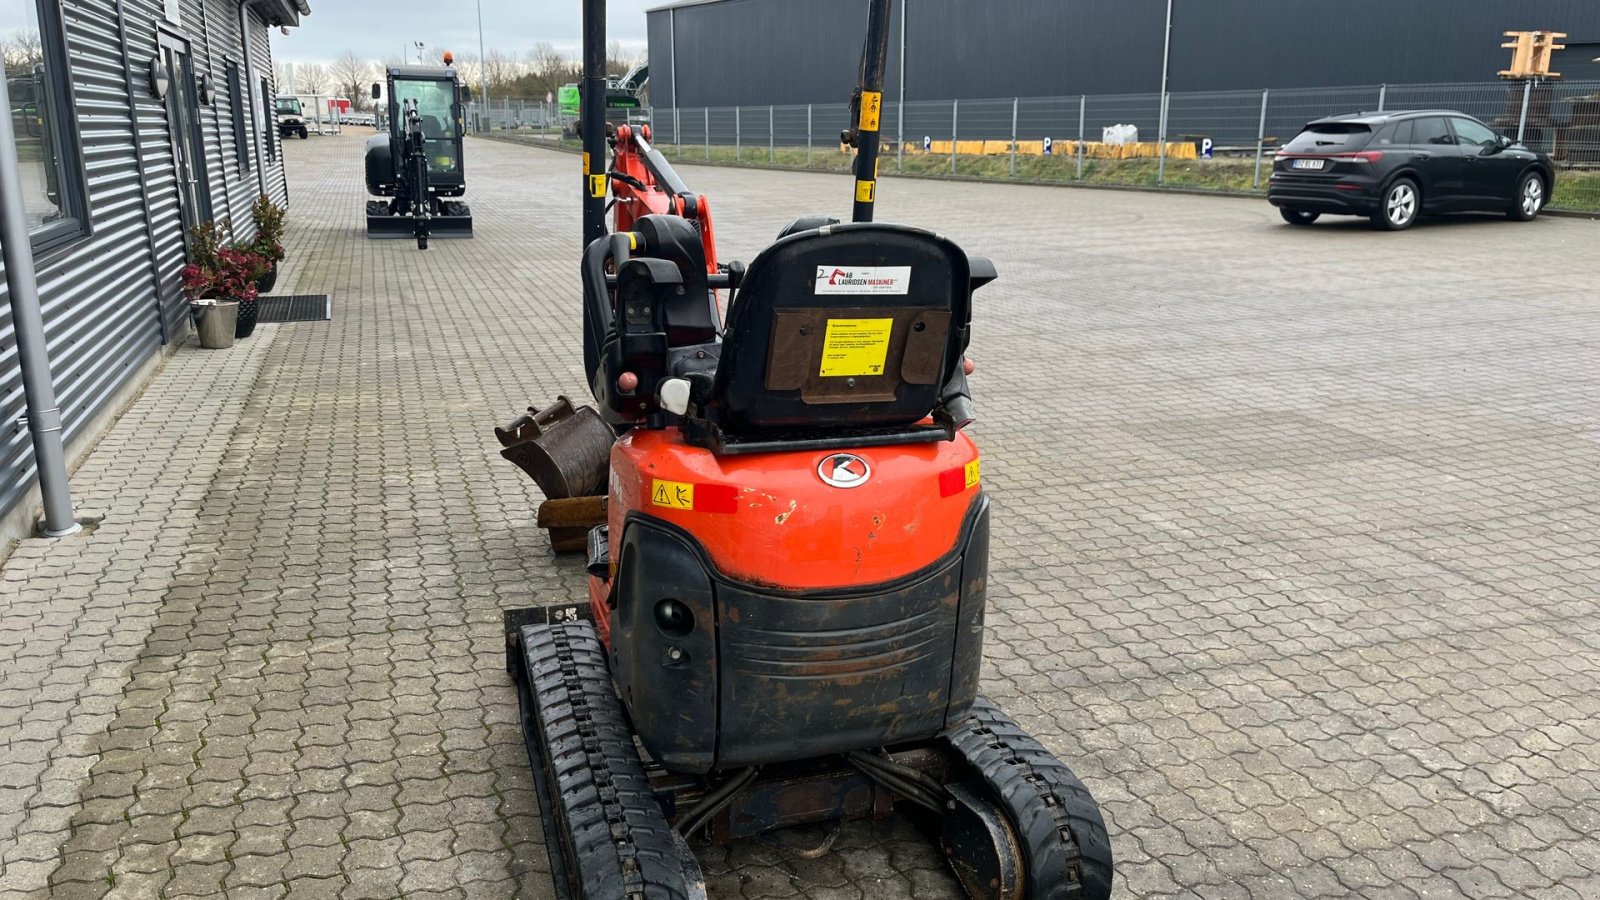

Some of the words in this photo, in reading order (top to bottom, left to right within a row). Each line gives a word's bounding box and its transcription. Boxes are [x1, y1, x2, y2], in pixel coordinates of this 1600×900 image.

[924, 136, 931, 148] P
[1044, 137, 1052, 151] P
[1201, 138, 1212, 154] P
[816, 268, 829, 279] 2
